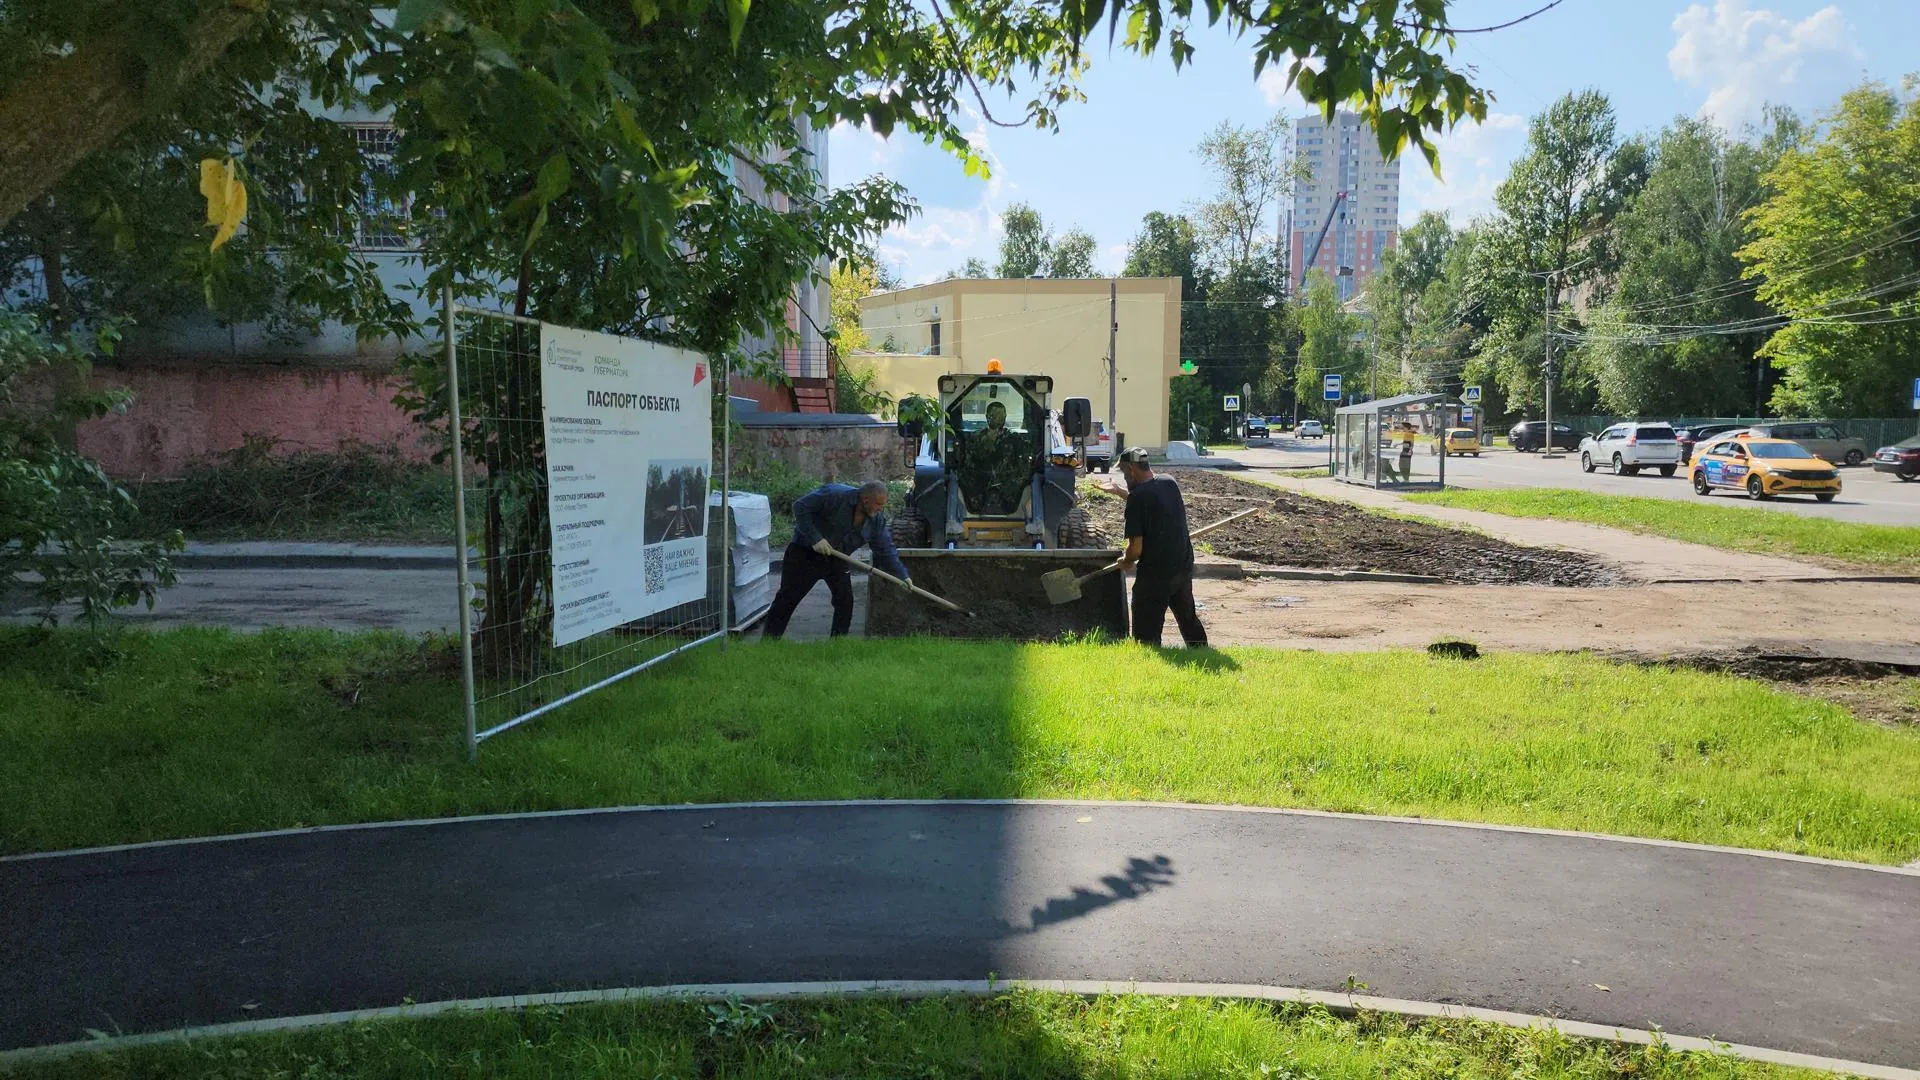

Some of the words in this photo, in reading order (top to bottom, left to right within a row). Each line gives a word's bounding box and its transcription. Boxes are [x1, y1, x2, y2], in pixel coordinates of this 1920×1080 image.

[593, 365, 629, 377] ГУБЕРНАТОРА
[587, 390, 637, 409] ПАСПОРТ
[639, 394, 680, 412] ОБЪЕКТА
